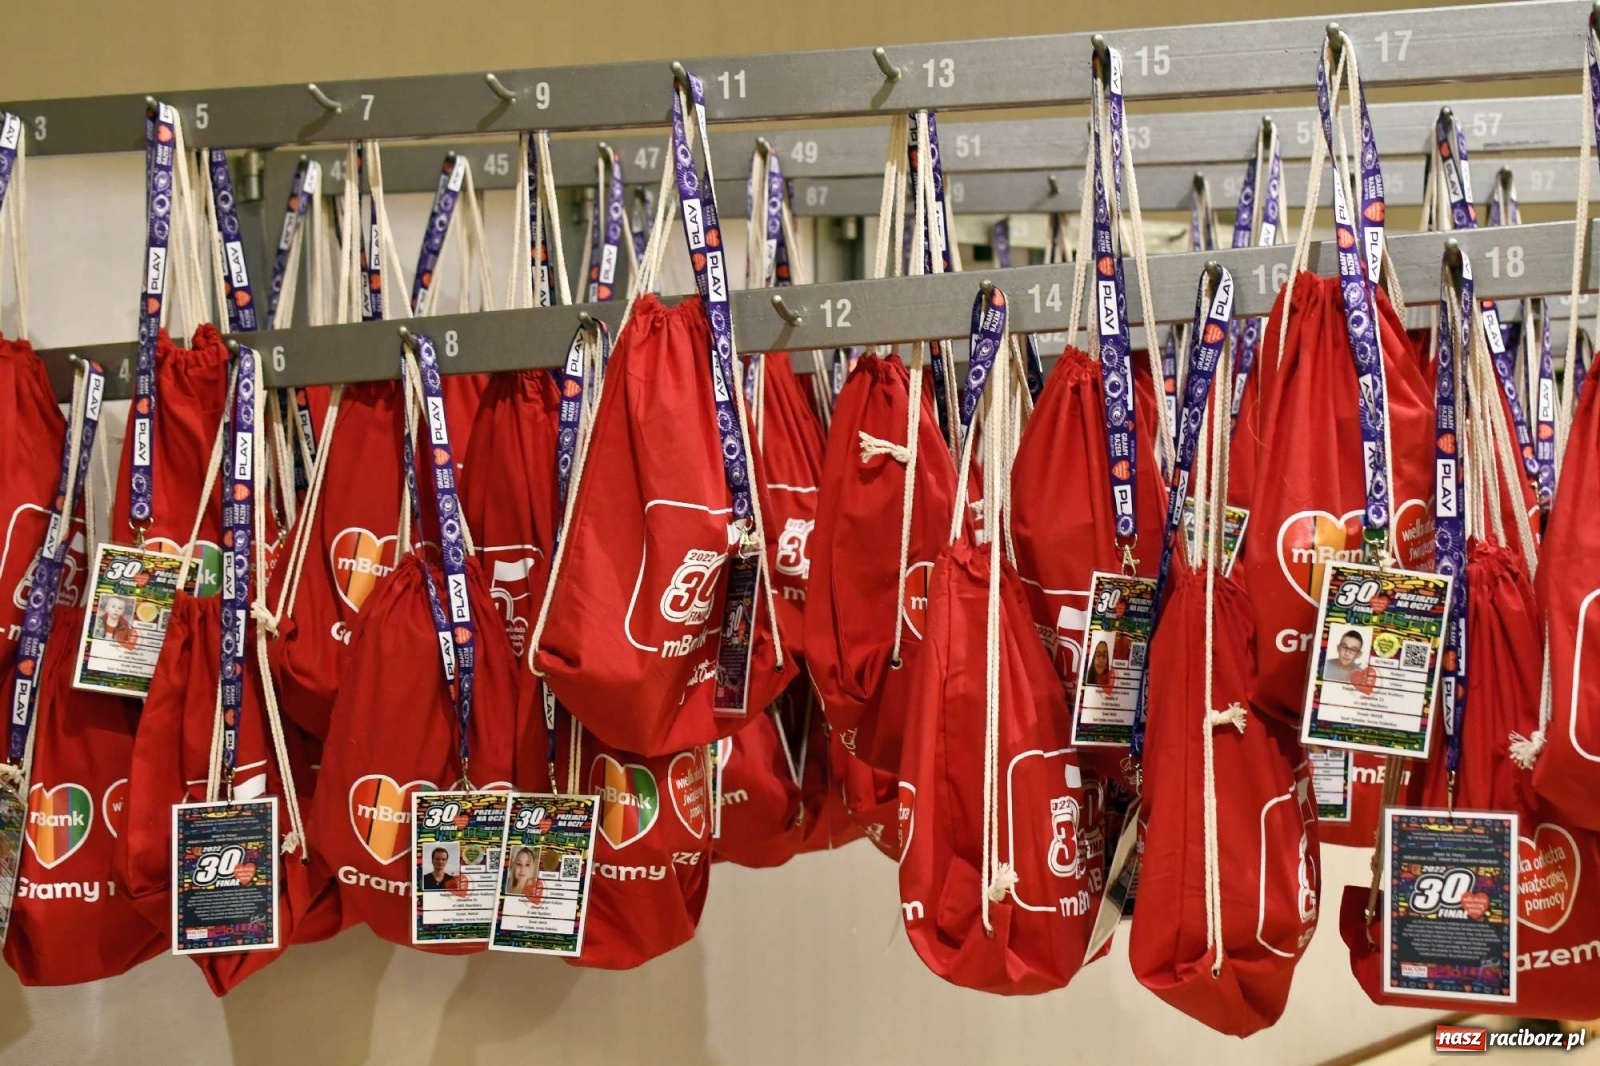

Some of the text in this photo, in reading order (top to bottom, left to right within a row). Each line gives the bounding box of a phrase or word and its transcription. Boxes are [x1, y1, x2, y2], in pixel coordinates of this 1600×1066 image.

[1136, 46, 1170, 76] 15
[1375, 31, 1412, 62] 17
[718, 70, 746, 99] 11
[923, 59, 954, 88] 13
[361, 95, 374, 120] 7
[536, 82, 550, 109] 9
[35, 116, 46, 140] 3
[196, 104, 208, 128] 5
[1473, 113, 1502, 137] 57
[956, 135, 981, 158] 51
[1129, 126, 1150, 149] 53
[484, 154, 509, 175] 45
[635, 148, 660, 169] 47
[791, 141, 818, 164] 49
[1531, 172, 1555, 190] 97
[806, 187, 828, 207] 87
[688, 204, 702, 245] PLAY
[230, 247, 244, 284] PLAY
[1370, 232, 1378, 277] PLAY
[1486, 246, 1524, 278] 18
[151, 252, 162, 290] PLAY
[710, 254, 722, 297] PLAY
[1252, 263, 1288, 294] 16
[1028, 284, 1062, 313] 14
[1102, 286, 1116, 330] PLAY
[1216, 271, 1232, 316] PLAY
[820, 299, 852, 328] 12
[984, 308, 994, 330] GRAMY
[990, 310, 1000, 332] RAZEM
[445, 331, 458, 357] 8
[1486, 314, 1500, 348] PLAY
[272, 346, 286, 372] 6
[570, 332, 584, 373] PLAY
[1197, 347, 1207, 370] GRAMY
[1203, 349, 1214, 371] RAZEM
[119, 358, 131, 382] 4
[90, 378, 100, 416] PLAY
[1542, 384, 1550, 418] PLAY
[432, 401, 443, 441] PLAY
[240, 437, 249, 476] PLAY
[1121, 433, 1129, 456] GRAMY
[1442, 464, 1452, 512] PLAY
[46, 517, 59, 554] PLAY
[106, 560, 142, 581] 30
[688, 552, 714, 562] 2022
[454, 580, 464, 618] PLAY
[667, 566, 722, 615] 30
[1097, 589, 1121, 612] 30
[1337, 580, 1380, 606] 30
[1410, 602, 1434, 611] OCZY
[442, 636, 454, 676] PLAY
[16, 683, 28, 721] PLAY
[1444, 682, 1452, 730] PLAY
[425, 804, 459, 826] 30
[516, 807, 546, 829] 30
[196, 848, 242, 882] 30
[592, 862, 666, 881] ramy
[1422, 866, 1446, 874] 2022
[18, 877, 100, 902] Gramy
[338, 866, 412, 898] Gram
[1414, 872, 1470, 910] 30
[1525, 891, 1564, 916] pomocy
[1516, 939, 1600, 972] azem
